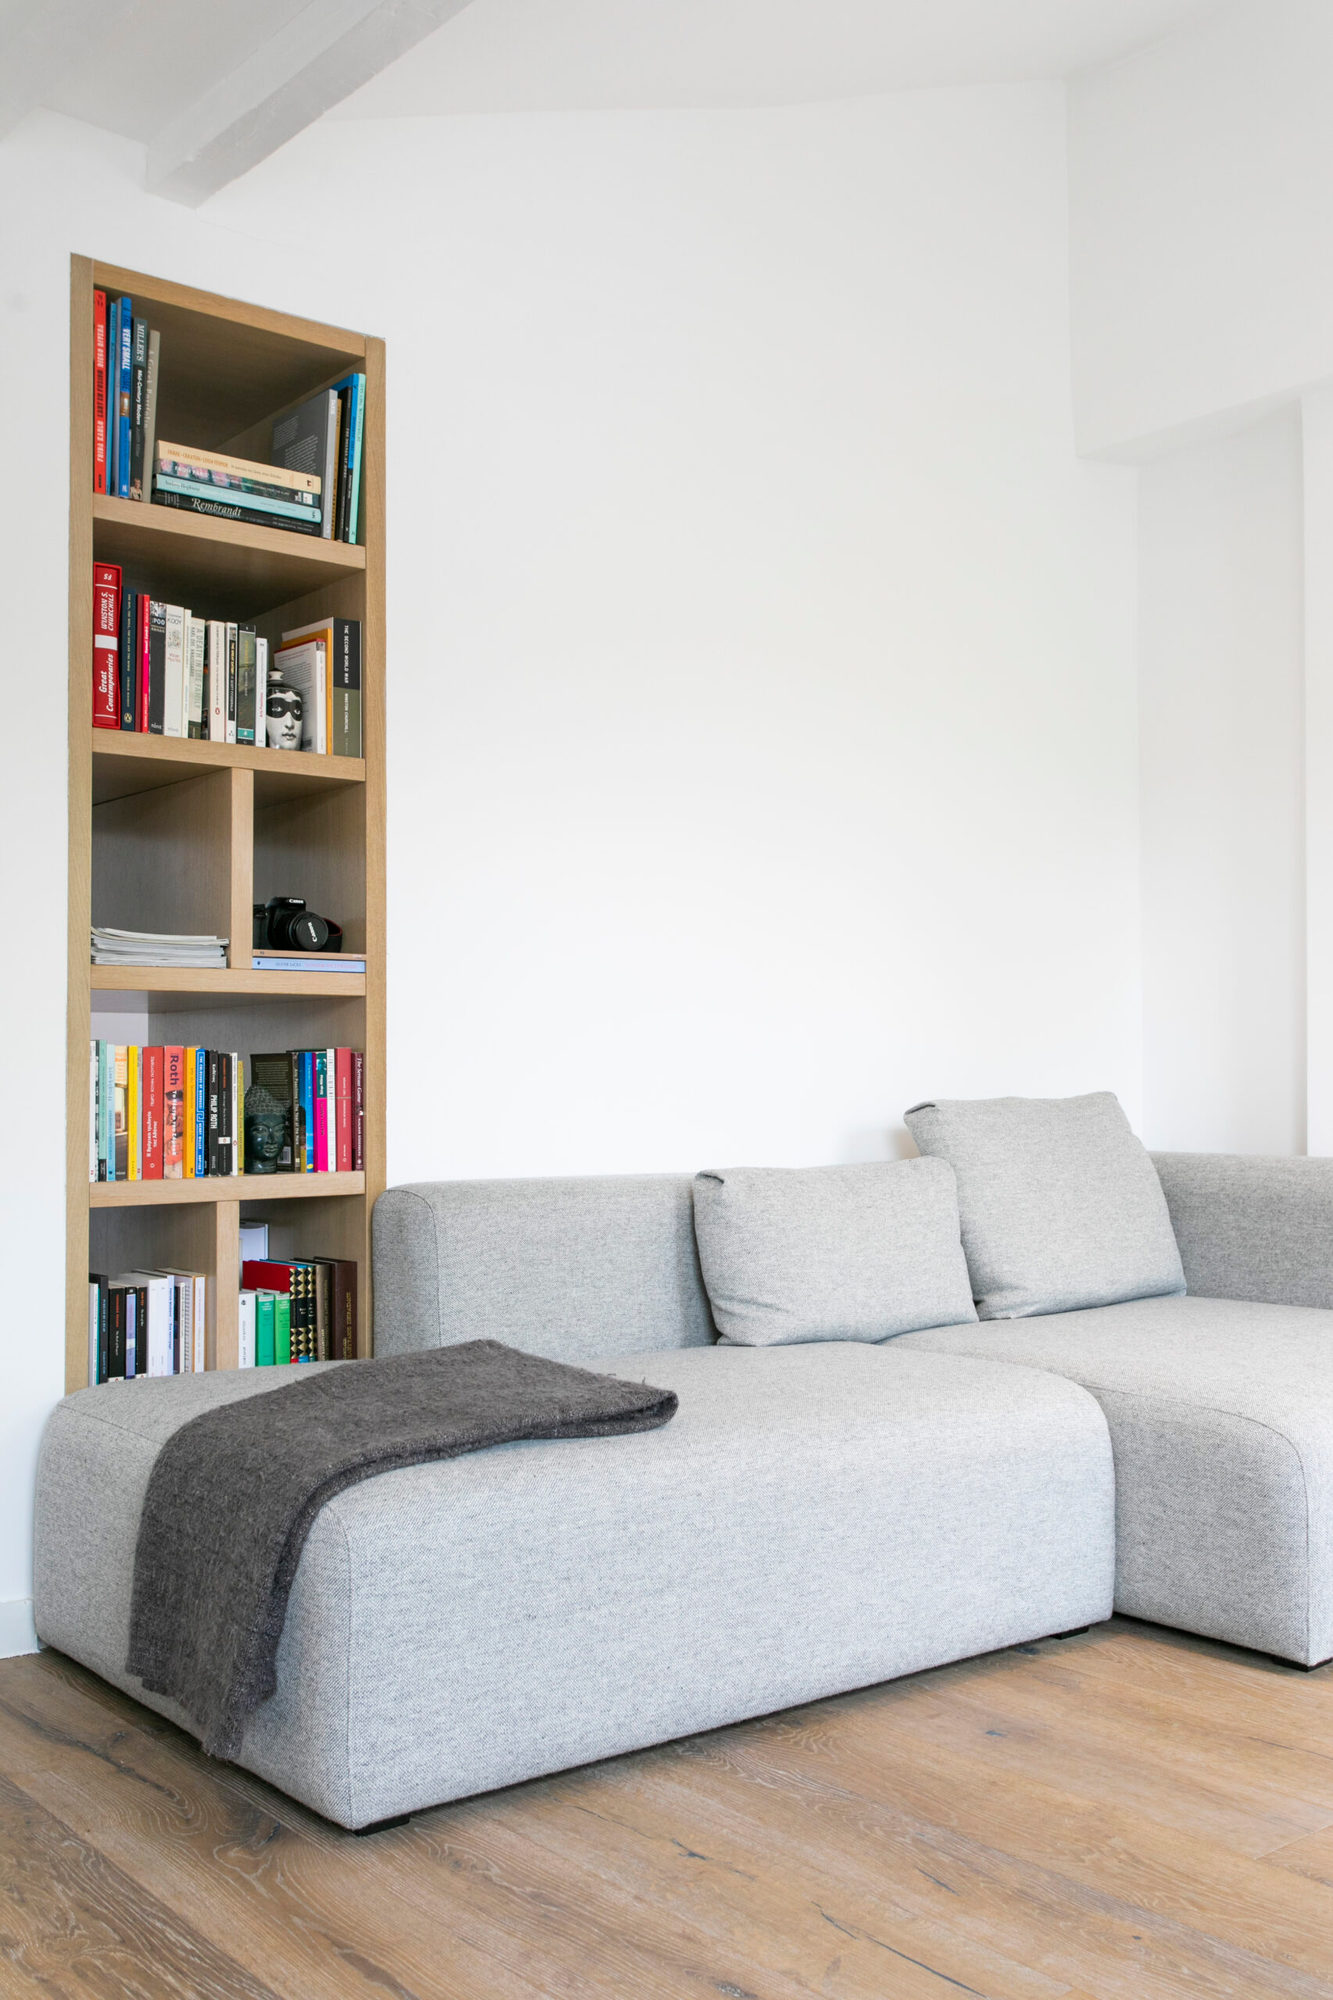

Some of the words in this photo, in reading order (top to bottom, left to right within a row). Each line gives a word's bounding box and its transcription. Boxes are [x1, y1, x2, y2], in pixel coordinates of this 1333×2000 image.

[122, 328, 131, 346] VERY
[136, 323, 145, 362] MILLER'S
[121, 346, 131, 370] SMALL
[191, 498, 242, 517] Rembrandt
[98, 670, 108, 693] Great
[106, 653, 114, 712] Contemporaries
[307, 921, 318, 942] Canon
[170, 1055, 179, 1086] Roth
[210, 1113, 218, 1129] ROTH
